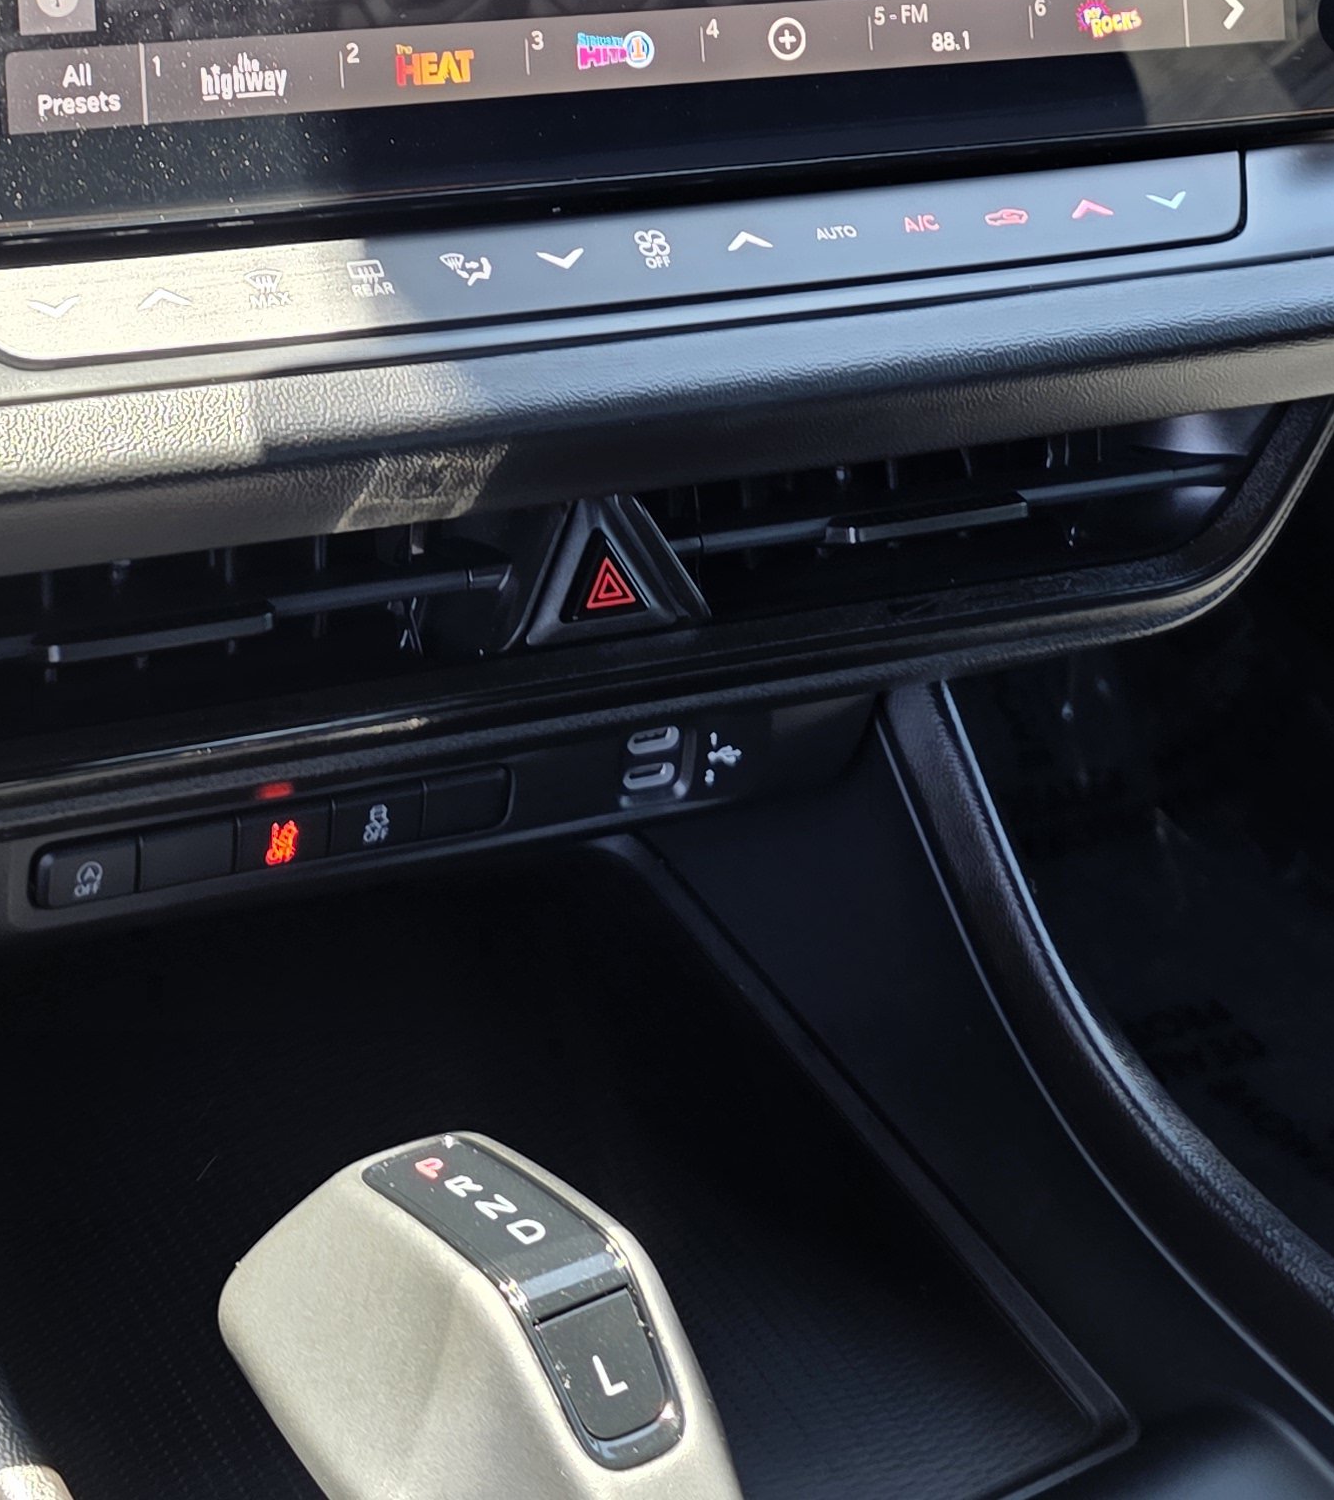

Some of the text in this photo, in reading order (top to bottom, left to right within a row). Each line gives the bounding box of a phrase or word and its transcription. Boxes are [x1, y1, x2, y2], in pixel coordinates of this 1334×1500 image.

[900, 3, 929, 24] FM
[1090, 9, 1142, 38] ROCKS
[705, 19, 720, 39] 4
[530, 31, 544, 51] 3
[931, 31, 970, 51] 88.1
[346, 42, 360, 64] 2
[62, 62, 92, 88] All
[151, 55, 161, 77] 1
[395, 49, 475, 87] HEAT
[200, 64, 287, 101] highway
[37, 91, 122, 117] Presets
[816, 224, 857, 241] AUTO
[903, 214, 940, 233] A/C
[646, 255, 671, 269] OFF
[351, 281, 395, 298] REAR
[414, 1157, 546, 1245] P R N D
[592, 1355, 628, 1396] L
